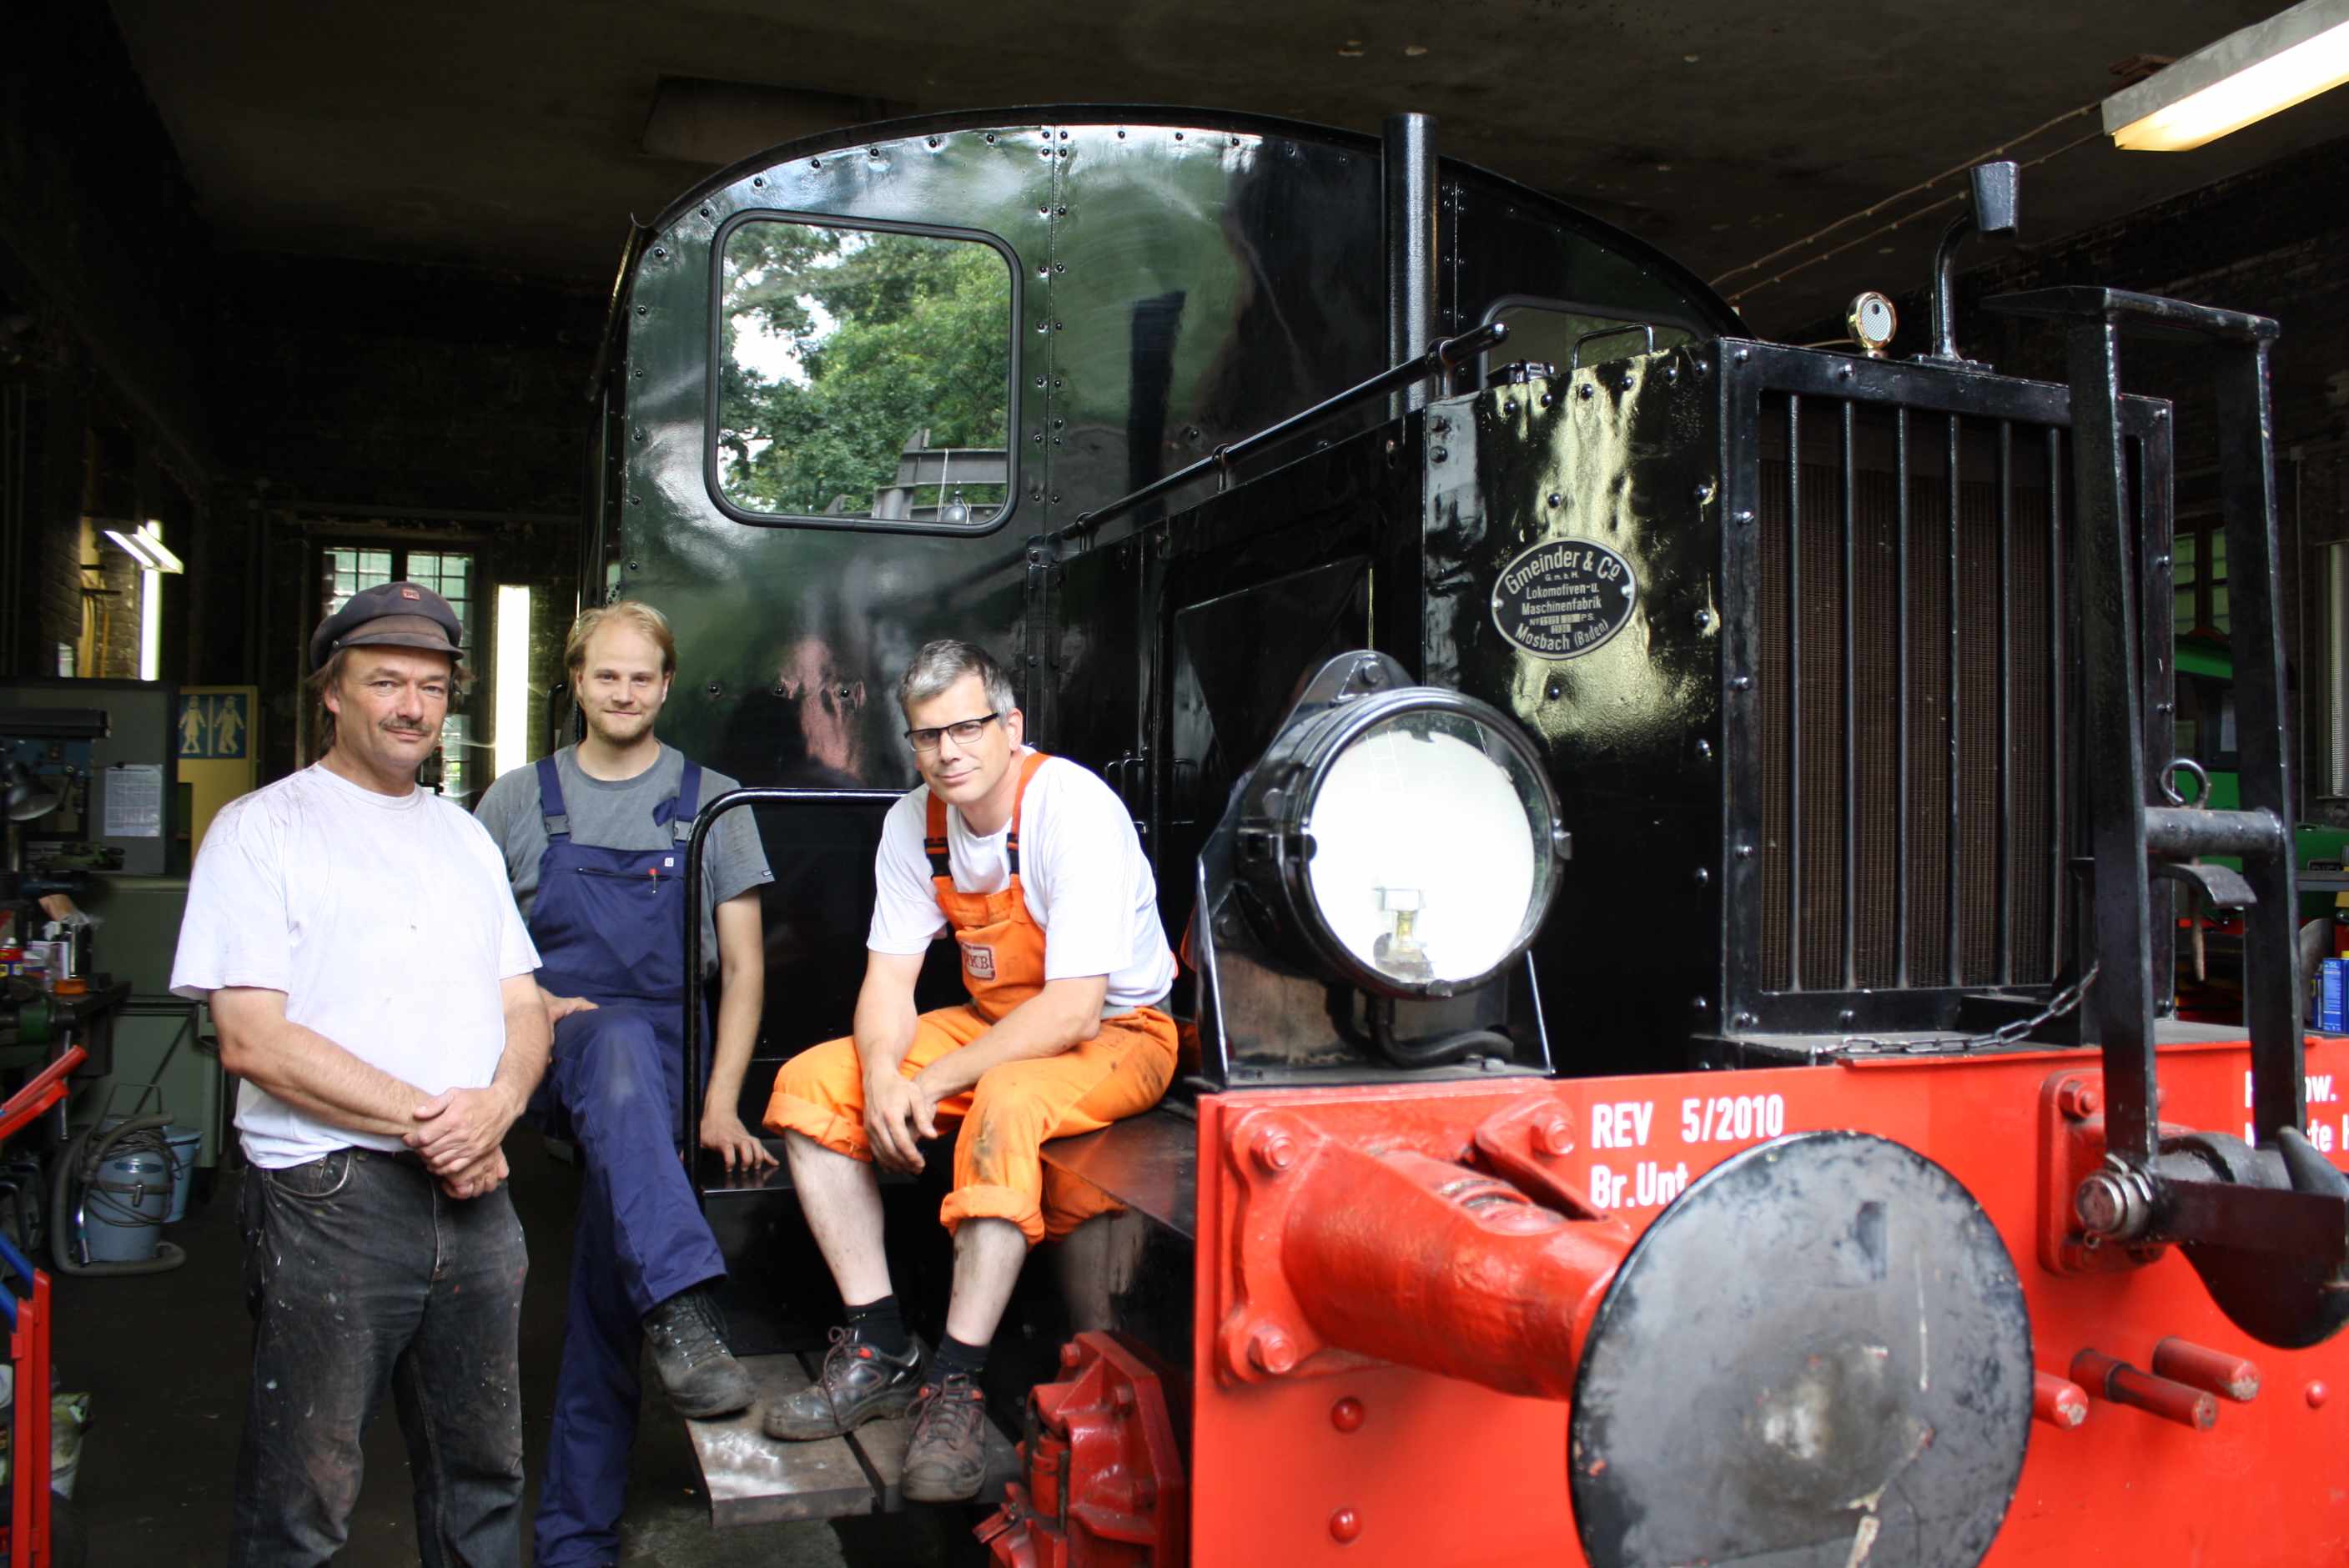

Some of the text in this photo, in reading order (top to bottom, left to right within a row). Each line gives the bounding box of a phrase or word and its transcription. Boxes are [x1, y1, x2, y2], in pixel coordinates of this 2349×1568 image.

[1505, 545, 1581, 595] Gmeinder
[1582, 550, 1594, 571] &
[1521, 596, 1602, 616] Maschinenfabrik
[1515, 623, 1570, 651] Mosbach
[1574, 618, 1609, 648] (Baden)
[1592, 1094, 1783, 1148] REV 5/2010
